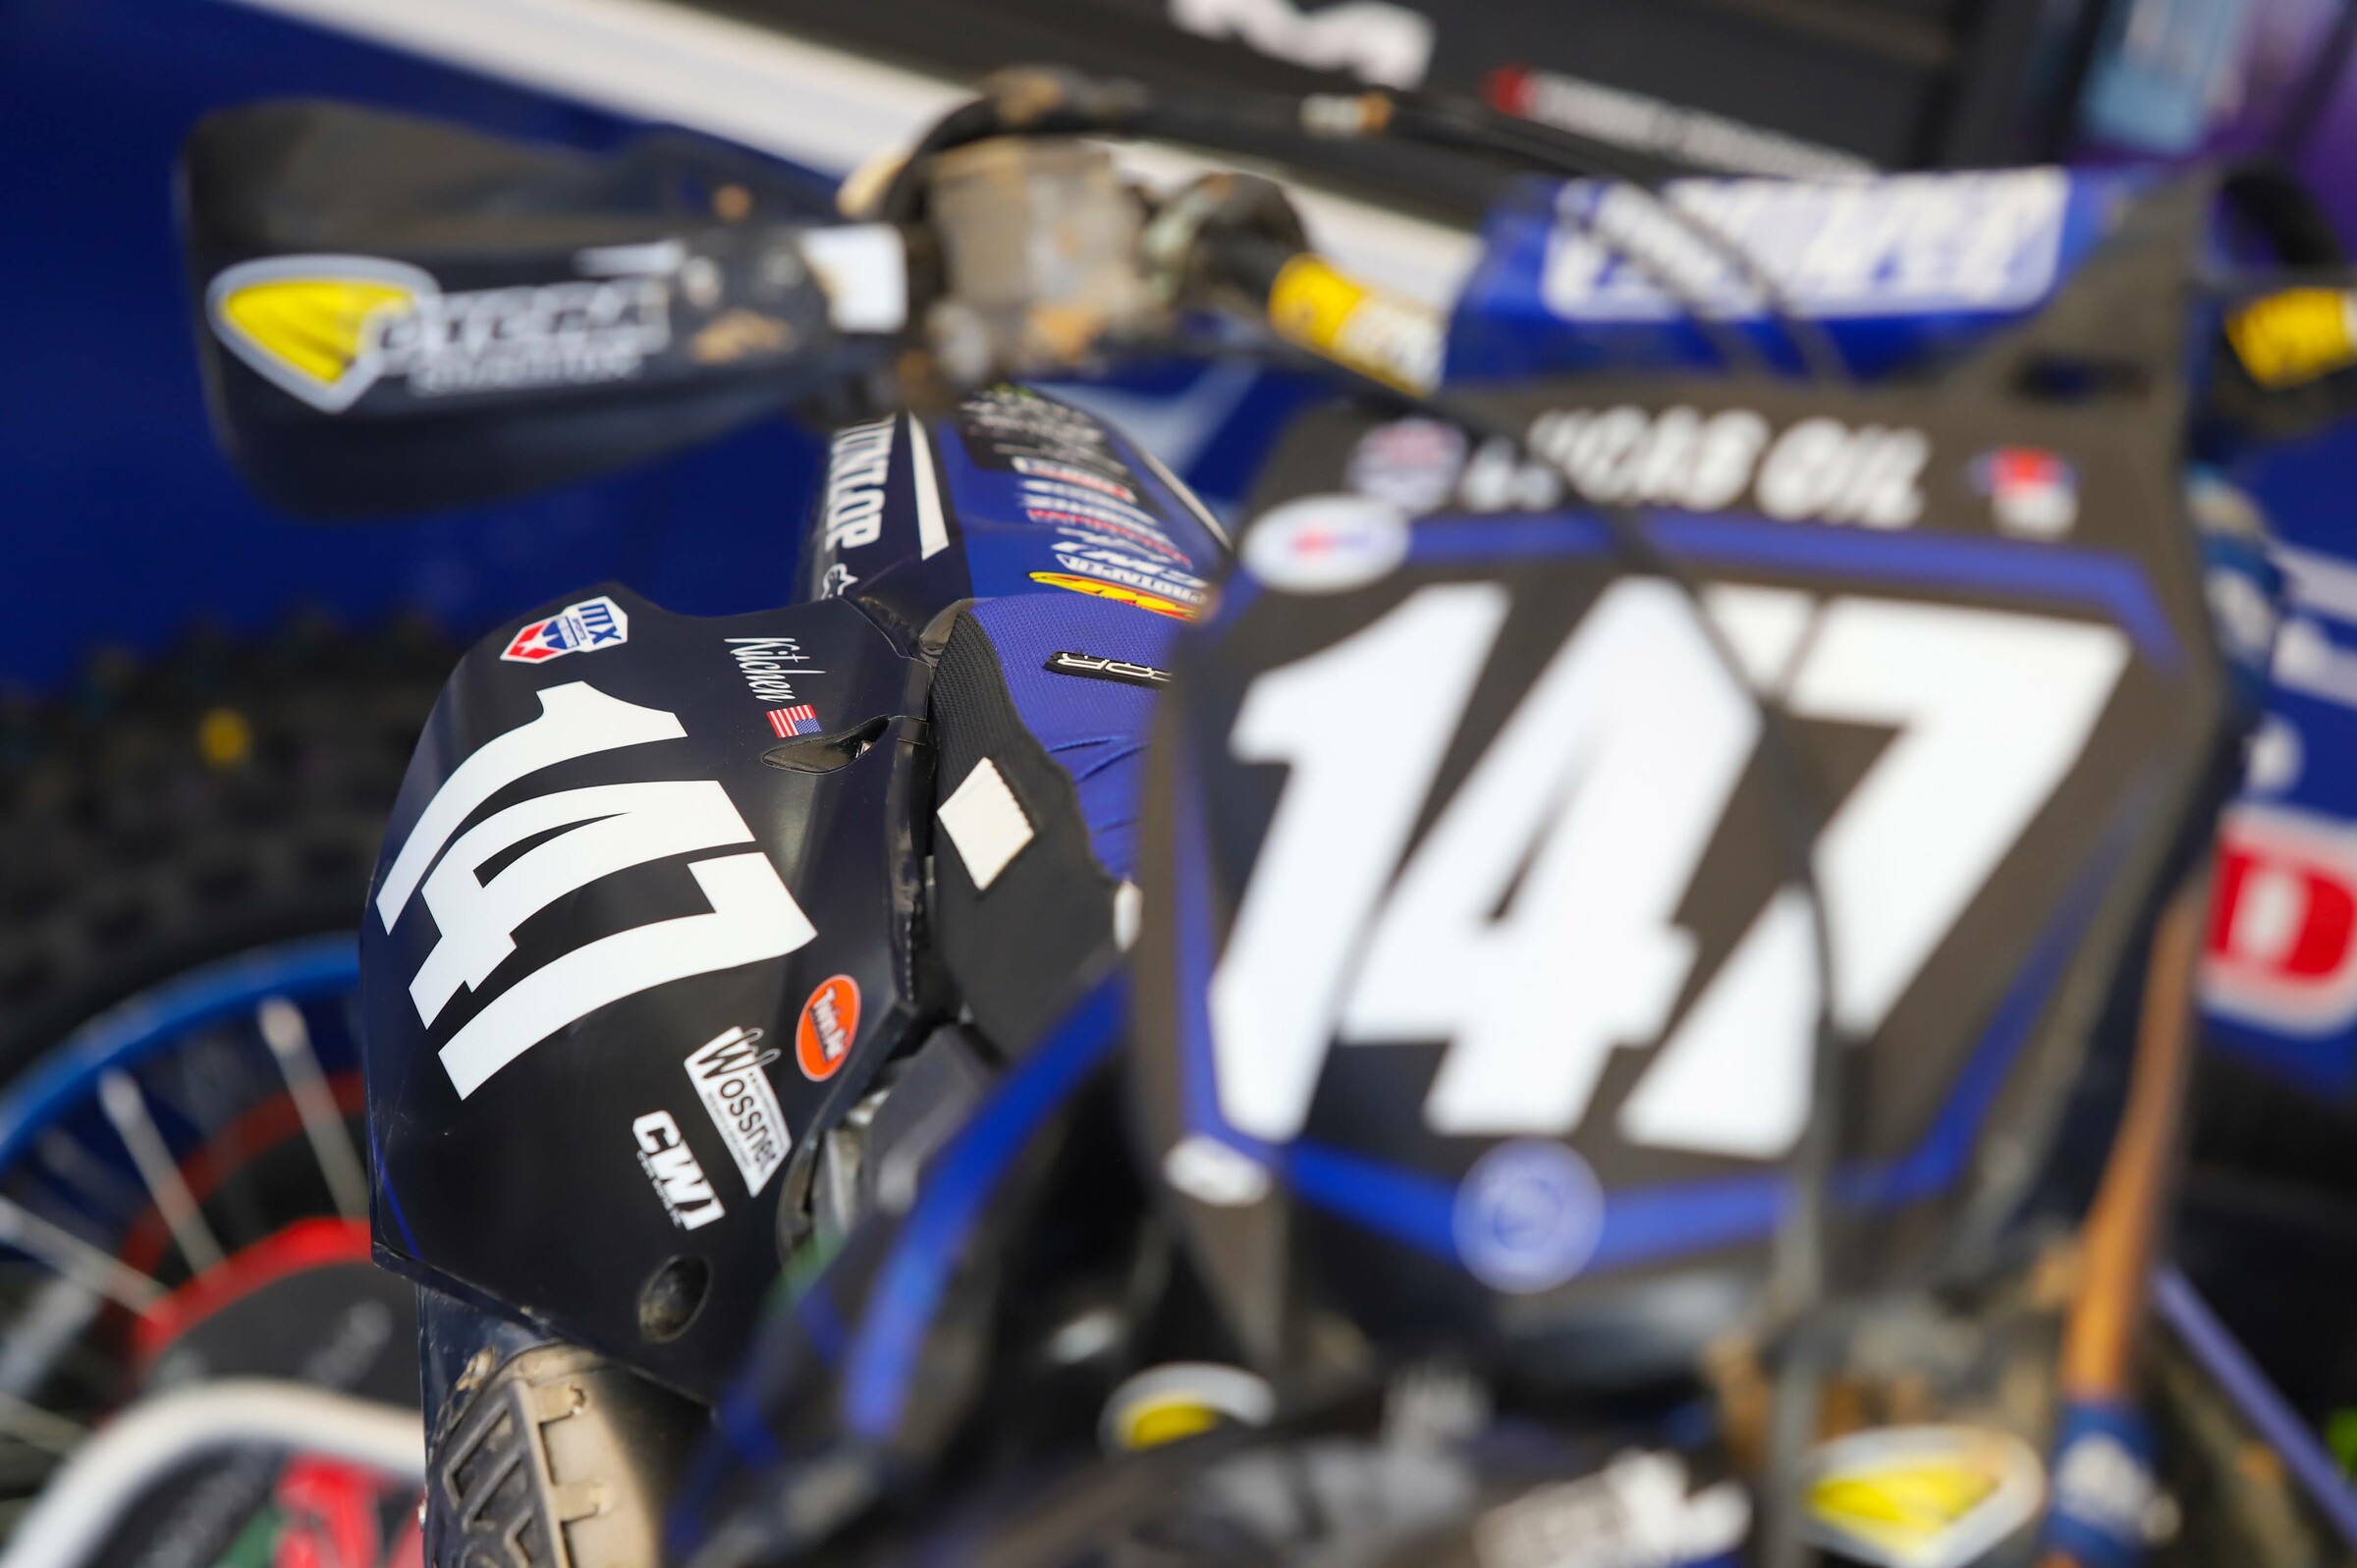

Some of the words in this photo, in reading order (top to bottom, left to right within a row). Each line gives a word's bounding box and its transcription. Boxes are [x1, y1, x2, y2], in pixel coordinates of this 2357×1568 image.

[577, 601, 623, 645] MX
[724, 637, 826, 703] Kitchen
[375, 680, 818, 1101] 147
[1208, 575, 2132, 1159] 147
